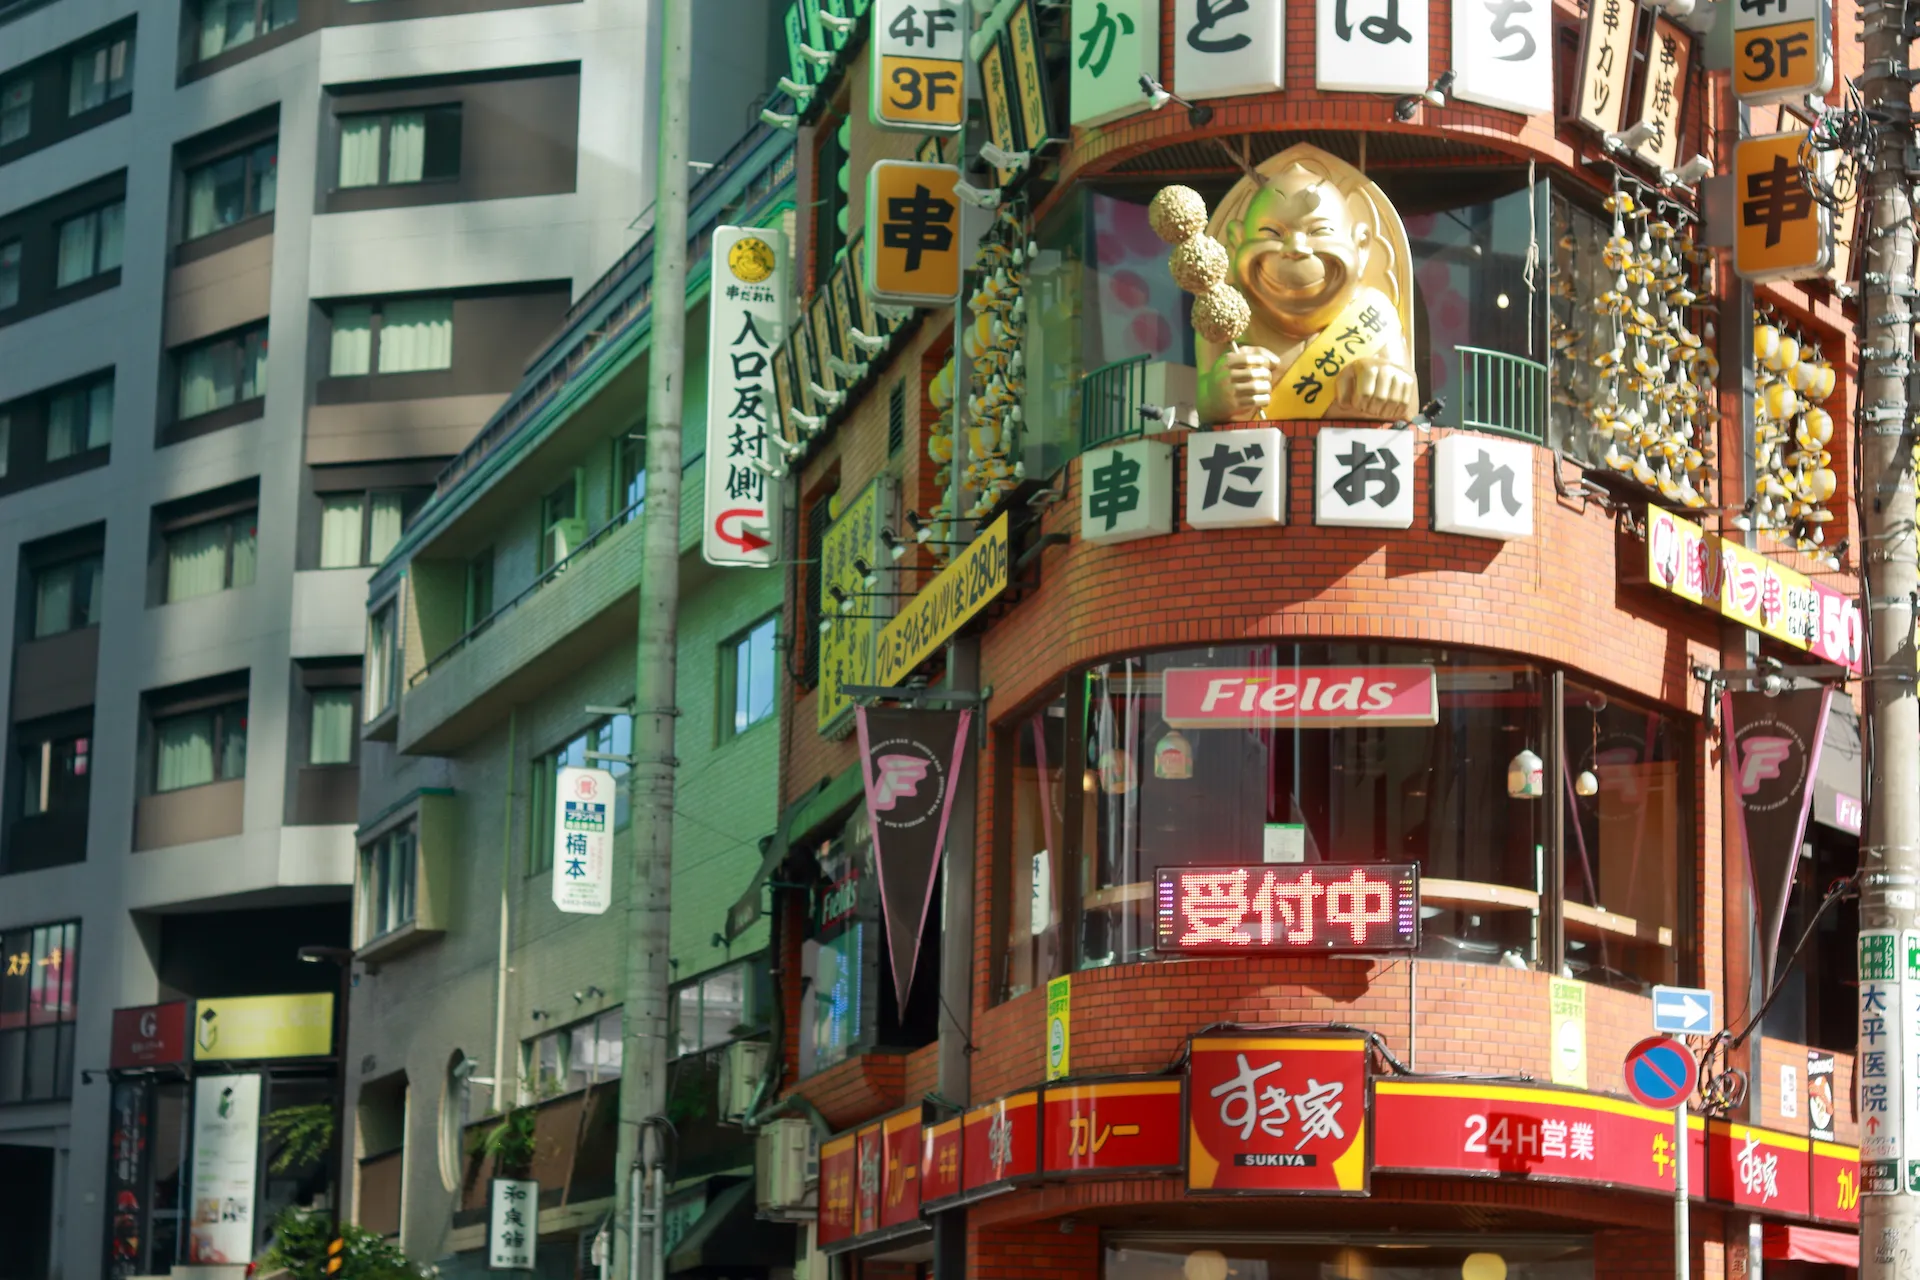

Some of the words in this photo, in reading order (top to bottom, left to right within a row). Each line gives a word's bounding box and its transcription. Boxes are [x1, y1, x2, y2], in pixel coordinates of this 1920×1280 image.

[888, 5, 957, 48] 4F
[1743, 32, 1808, 82] 3F
[889, 67, 957, 111] 3F
[883, 183, 955, 272] 串
[1743, 154, 1812, 249] 串
[726, 284, 775, 303] 串だおれ
[1292, 305, 1388, 404] 串だおれ
[725, 309, 769, 503] 入口反対側
[1089, 441, 1522, 531] 串だおれ
[1685, 533, 1782, 627] 豚バラ串
[1200, 676, 1397, 713] Fields
[565, 832, 588, 880] 楠本
[1180, 868, 1393, 946] 受付中
[1861, 983, 1888, 1112] 大平医院
[1068, 1110, 1140, 1157] カレー
[1209, 1053, 1344, 1151] すき家
[1463, 1113, 1595, 1161] 24H営業
[1243, 1154, 1306, 1167] SUKIYA
[1736, 1131, 1778, 1204] すき家
